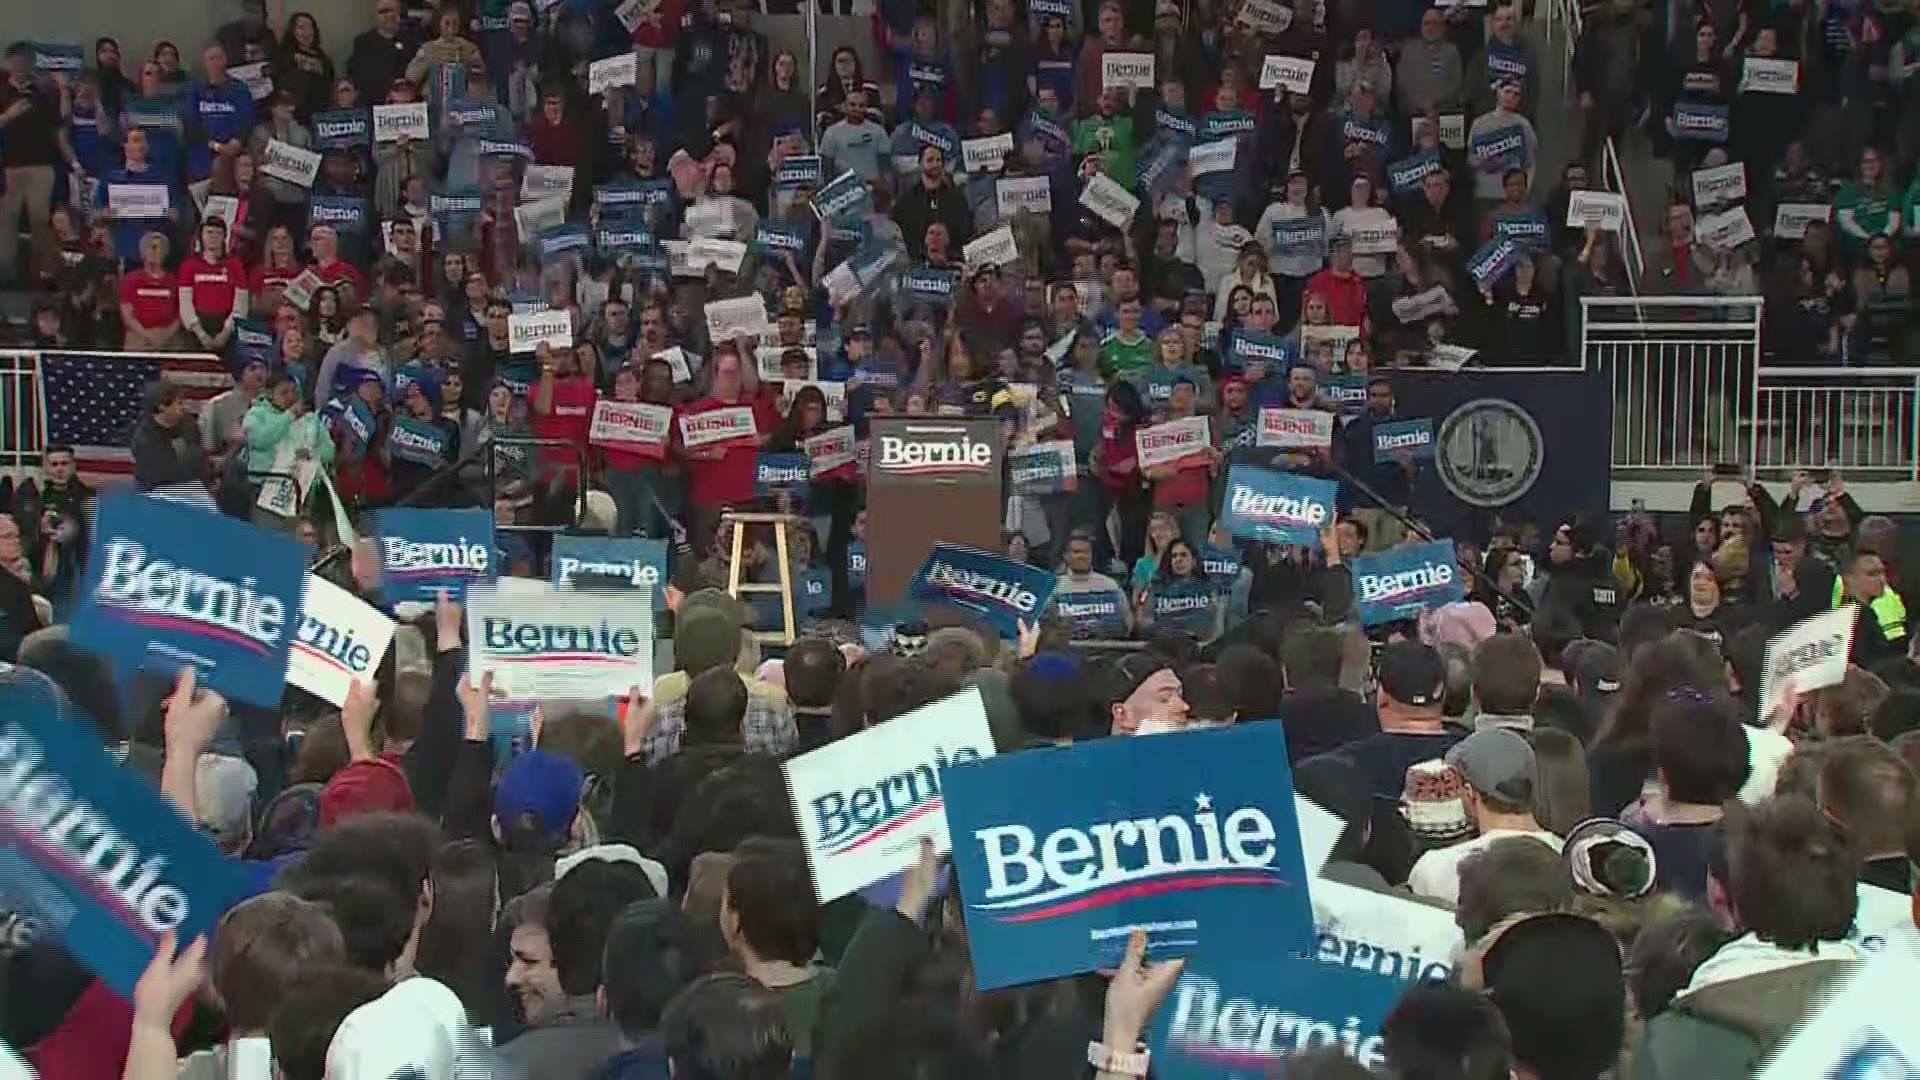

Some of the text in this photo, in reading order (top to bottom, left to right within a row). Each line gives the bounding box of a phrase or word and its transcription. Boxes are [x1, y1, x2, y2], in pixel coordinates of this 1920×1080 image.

[316, 118, 366, 137] Bernie
[377, 112, 425, 129] Bernie
[1497, 219, 1544, 235] Bernie
[1235, 338, 1285, 361] Bernie
[599, 411, 653, 433] BERNIE
[392, 426, 441, 453] Bernie
[880, 436, 991, 465] Bernie
[1377, 430, 1430, 448] Bernie
[1231, 485, 1325, 524] Bernie
[383, 535, 488, 572] Bernie
[97, 537, 286, 647] Bernie
[927, 559, 1038, 613] Bernie
[1360, 561, 1453, 600] Bernie
[1156, 589, 1209, 611] Bernie
[485, 617, 641, 657] Bernie
[974, 793, 1276, 898] Bernie
